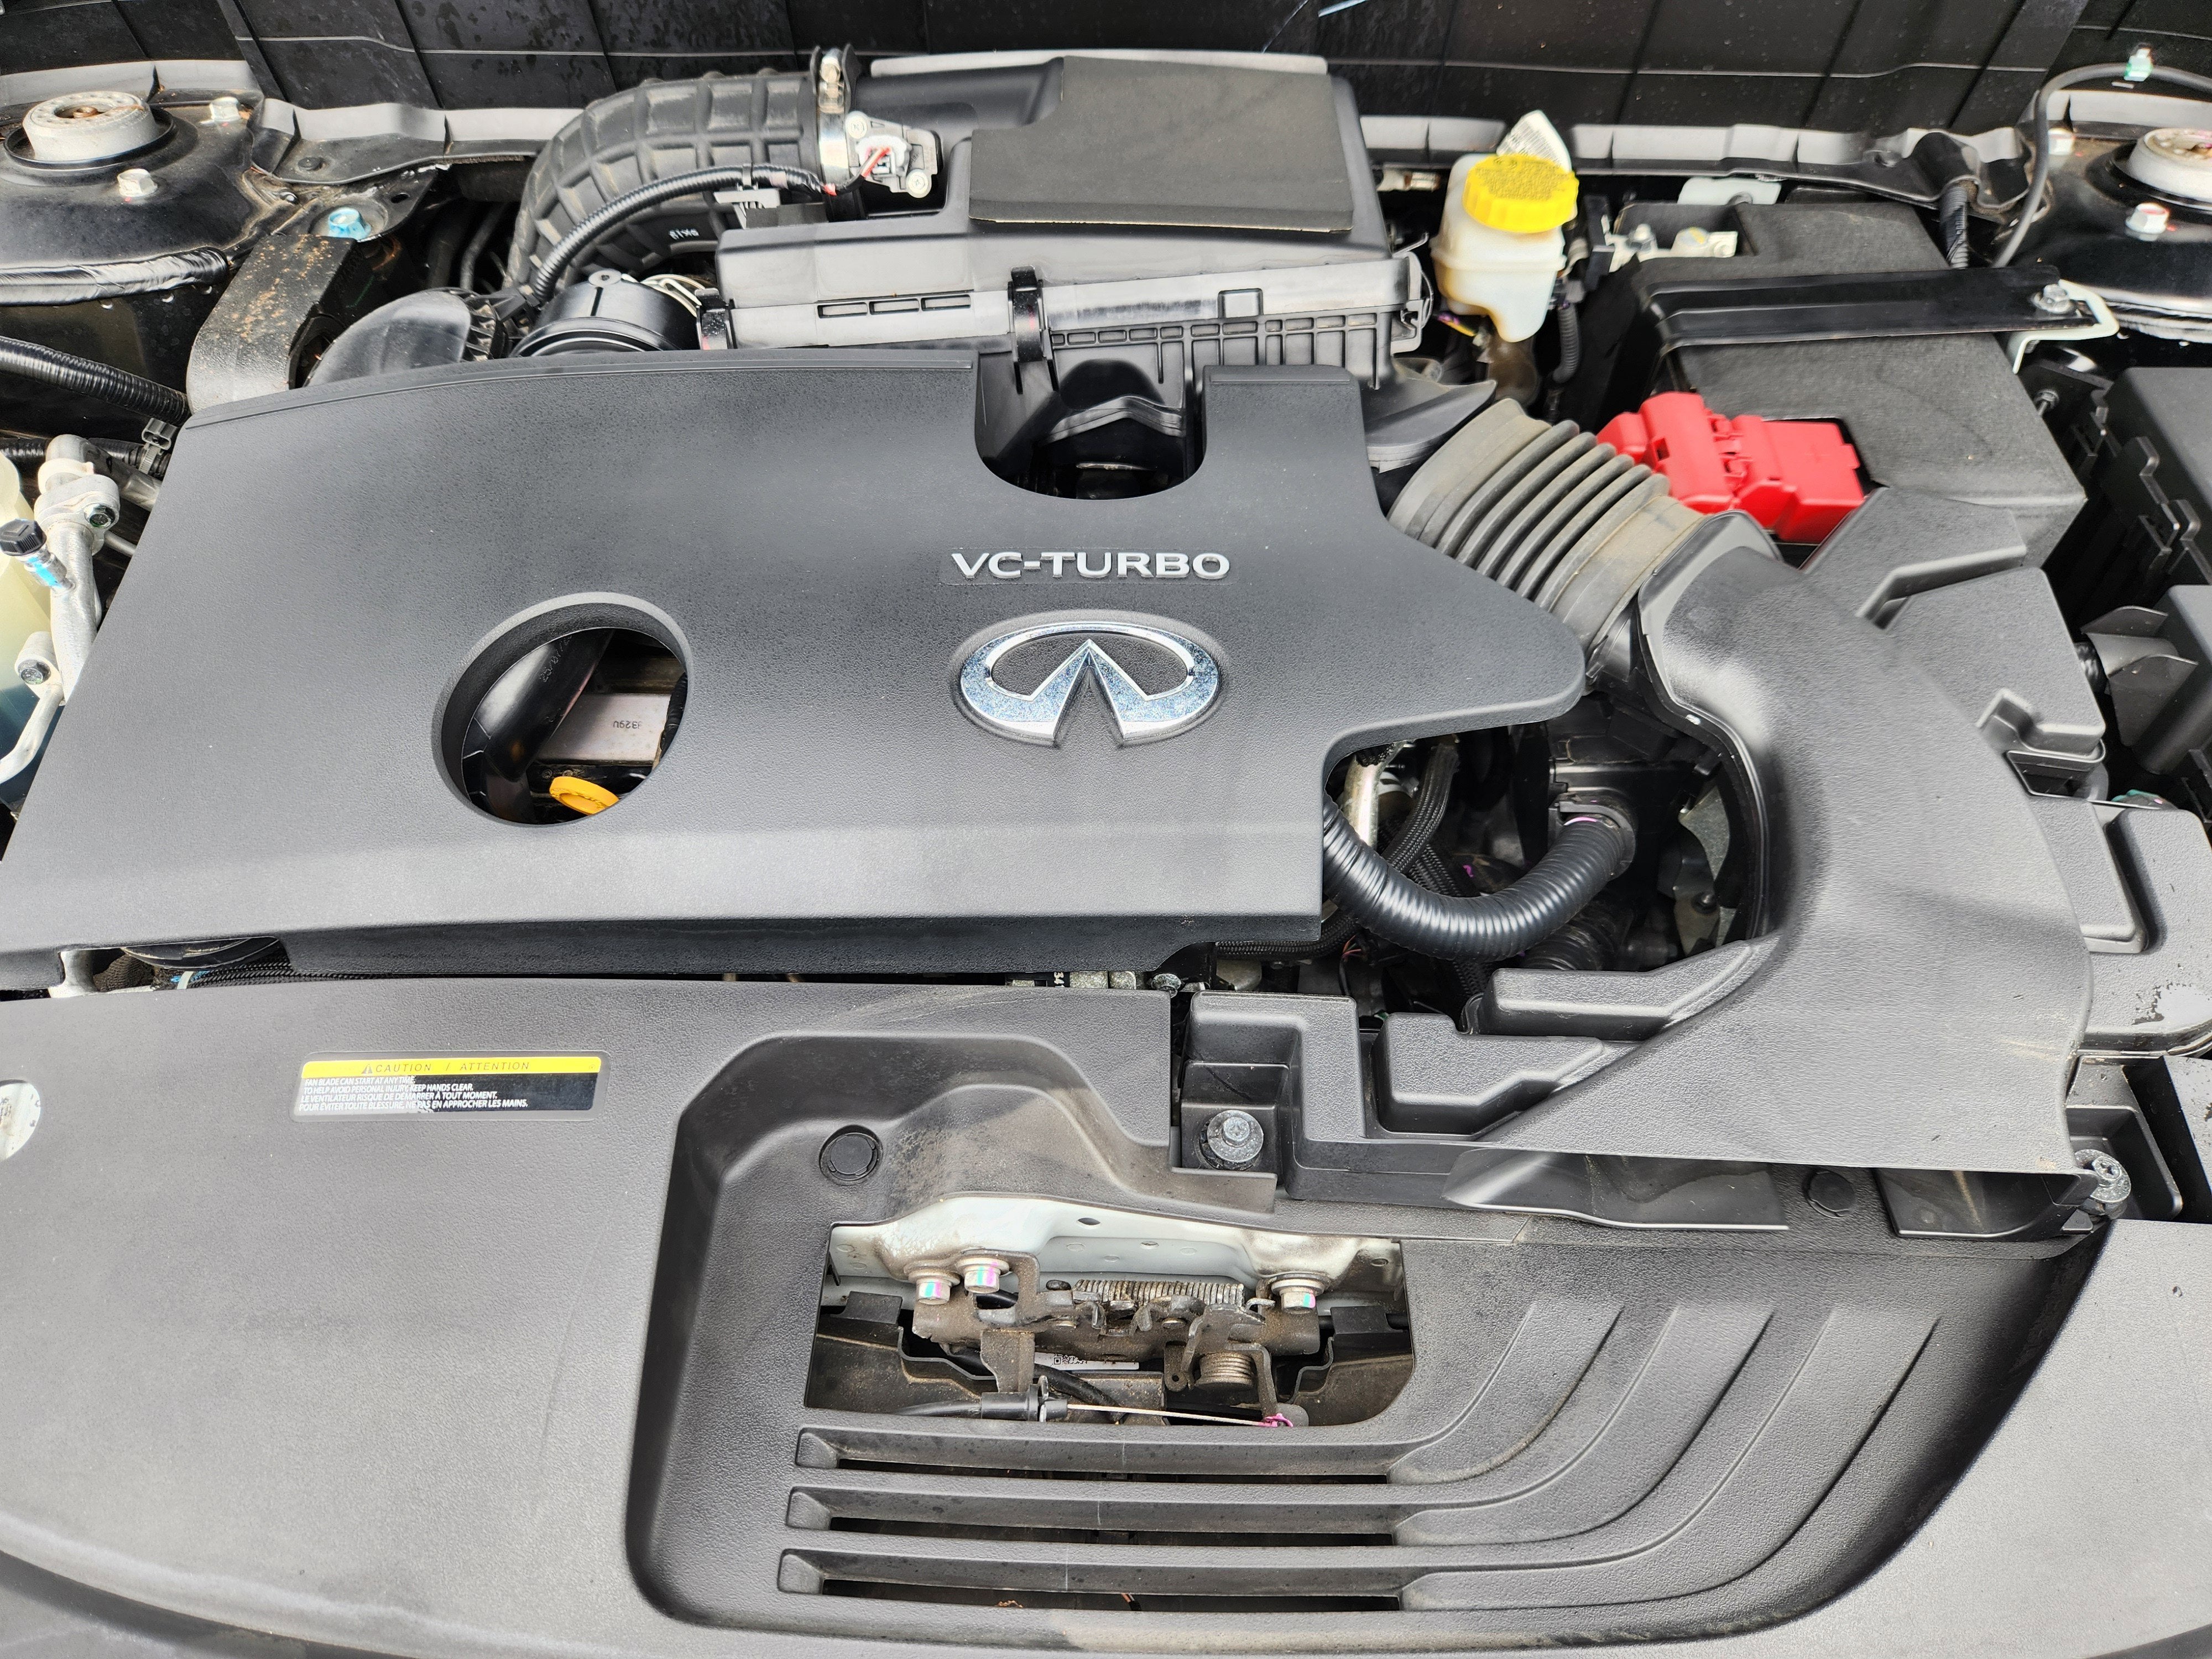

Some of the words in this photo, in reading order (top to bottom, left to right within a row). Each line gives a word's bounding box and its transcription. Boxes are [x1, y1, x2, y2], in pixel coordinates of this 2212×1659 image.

[951, 551, 1231, 580] VC-TURBO
[375, 1063, 431, 1072] CAUTION
[460, 1062, 529, 1071] ATTENTION
[304, 1087, 313, 1095] TO
[351, 1085, 384, 1093] PERSONAL
[426, 1083, 451, 1092] HANDS
[301, 1095, 310, 1103] LE
[310, 1094, 356, 1102] VENTILATEUR
[357, 1093, 384, 1102] RISQUE
[384, 1093, 395, 1101] DE
[299, 1103, 319, 1112] POUR
[343, 1102, 368, 1110] TOUTE
[432, 1100, 442, 1109] EN
[442, 1099, 488, 1109] APPROCHER
[488, 1099, 502, 1108] LES
